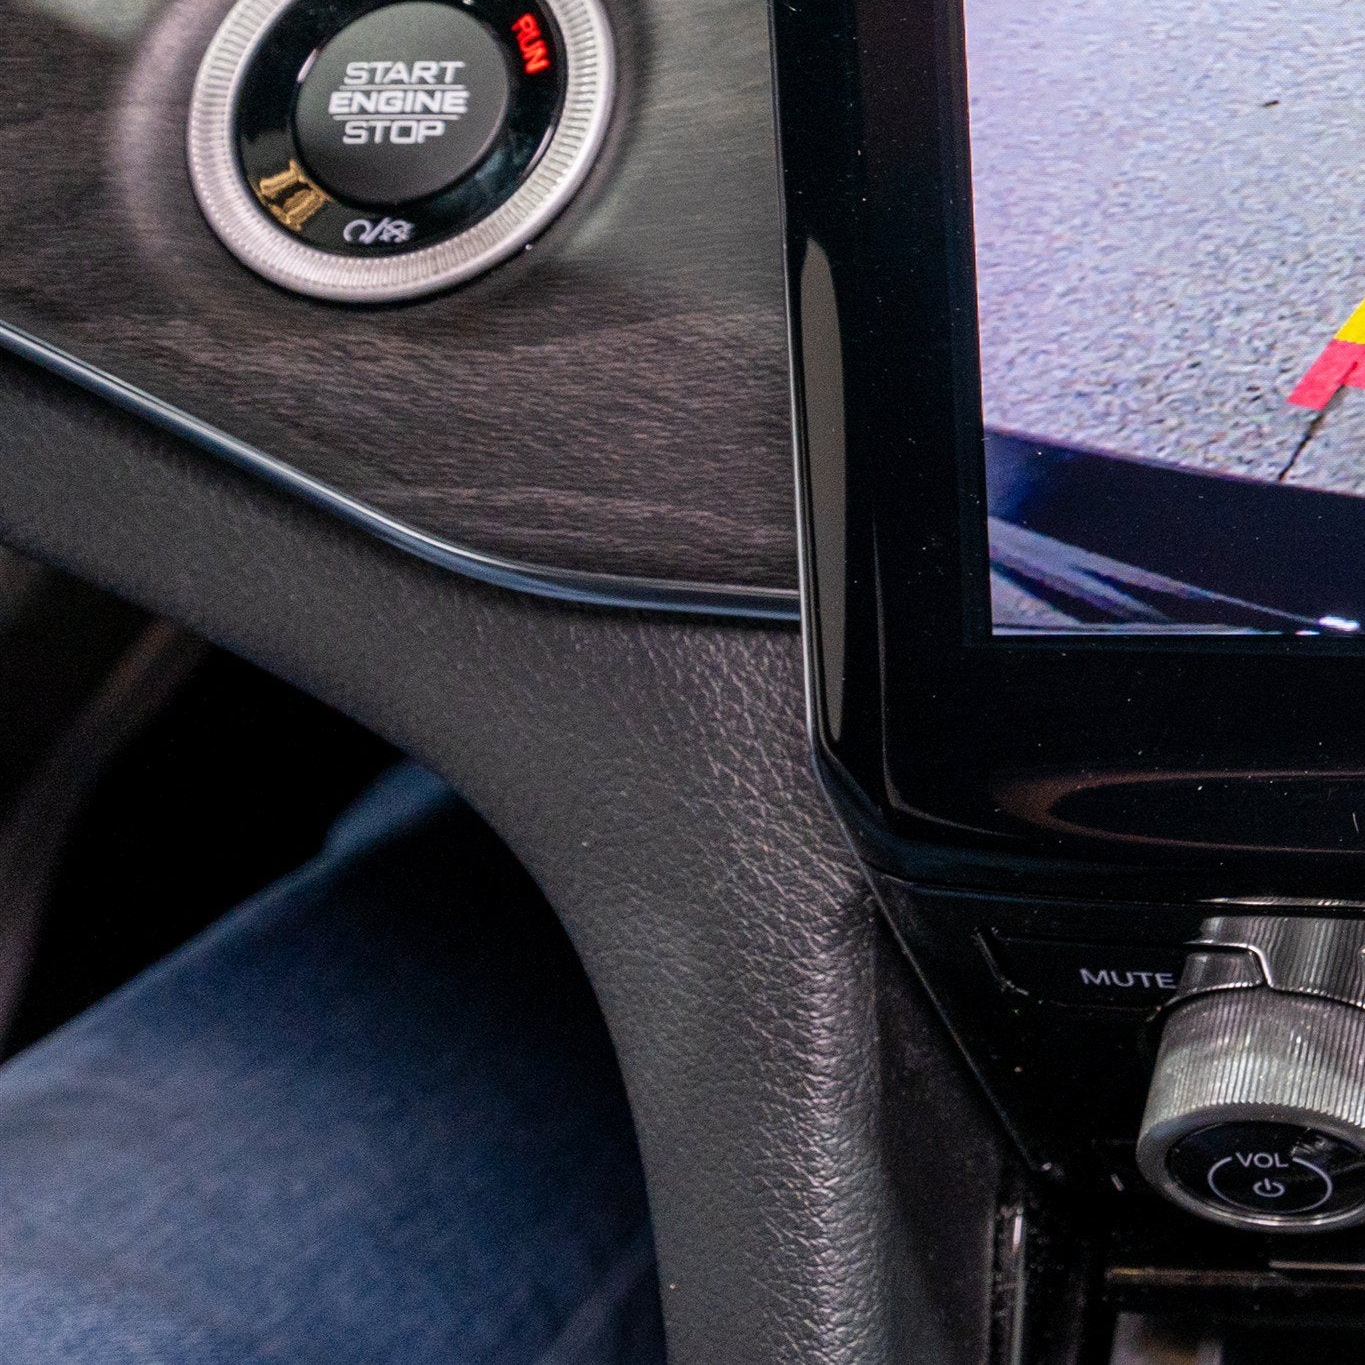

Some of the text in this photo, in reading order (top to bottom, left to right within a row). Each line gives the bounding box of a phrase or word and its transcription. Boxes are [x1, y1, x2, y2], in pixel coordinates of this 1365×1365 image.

[511, 13, 550, 73] RUN
[343, 61, 466, 84] START
[328, 90, 471, 113] ENGINE
[342, 120, 446, 144] STOP
[1080, 967, 1177, 990] MUTE
[1235, 1152, 1289, 1168] VOL
